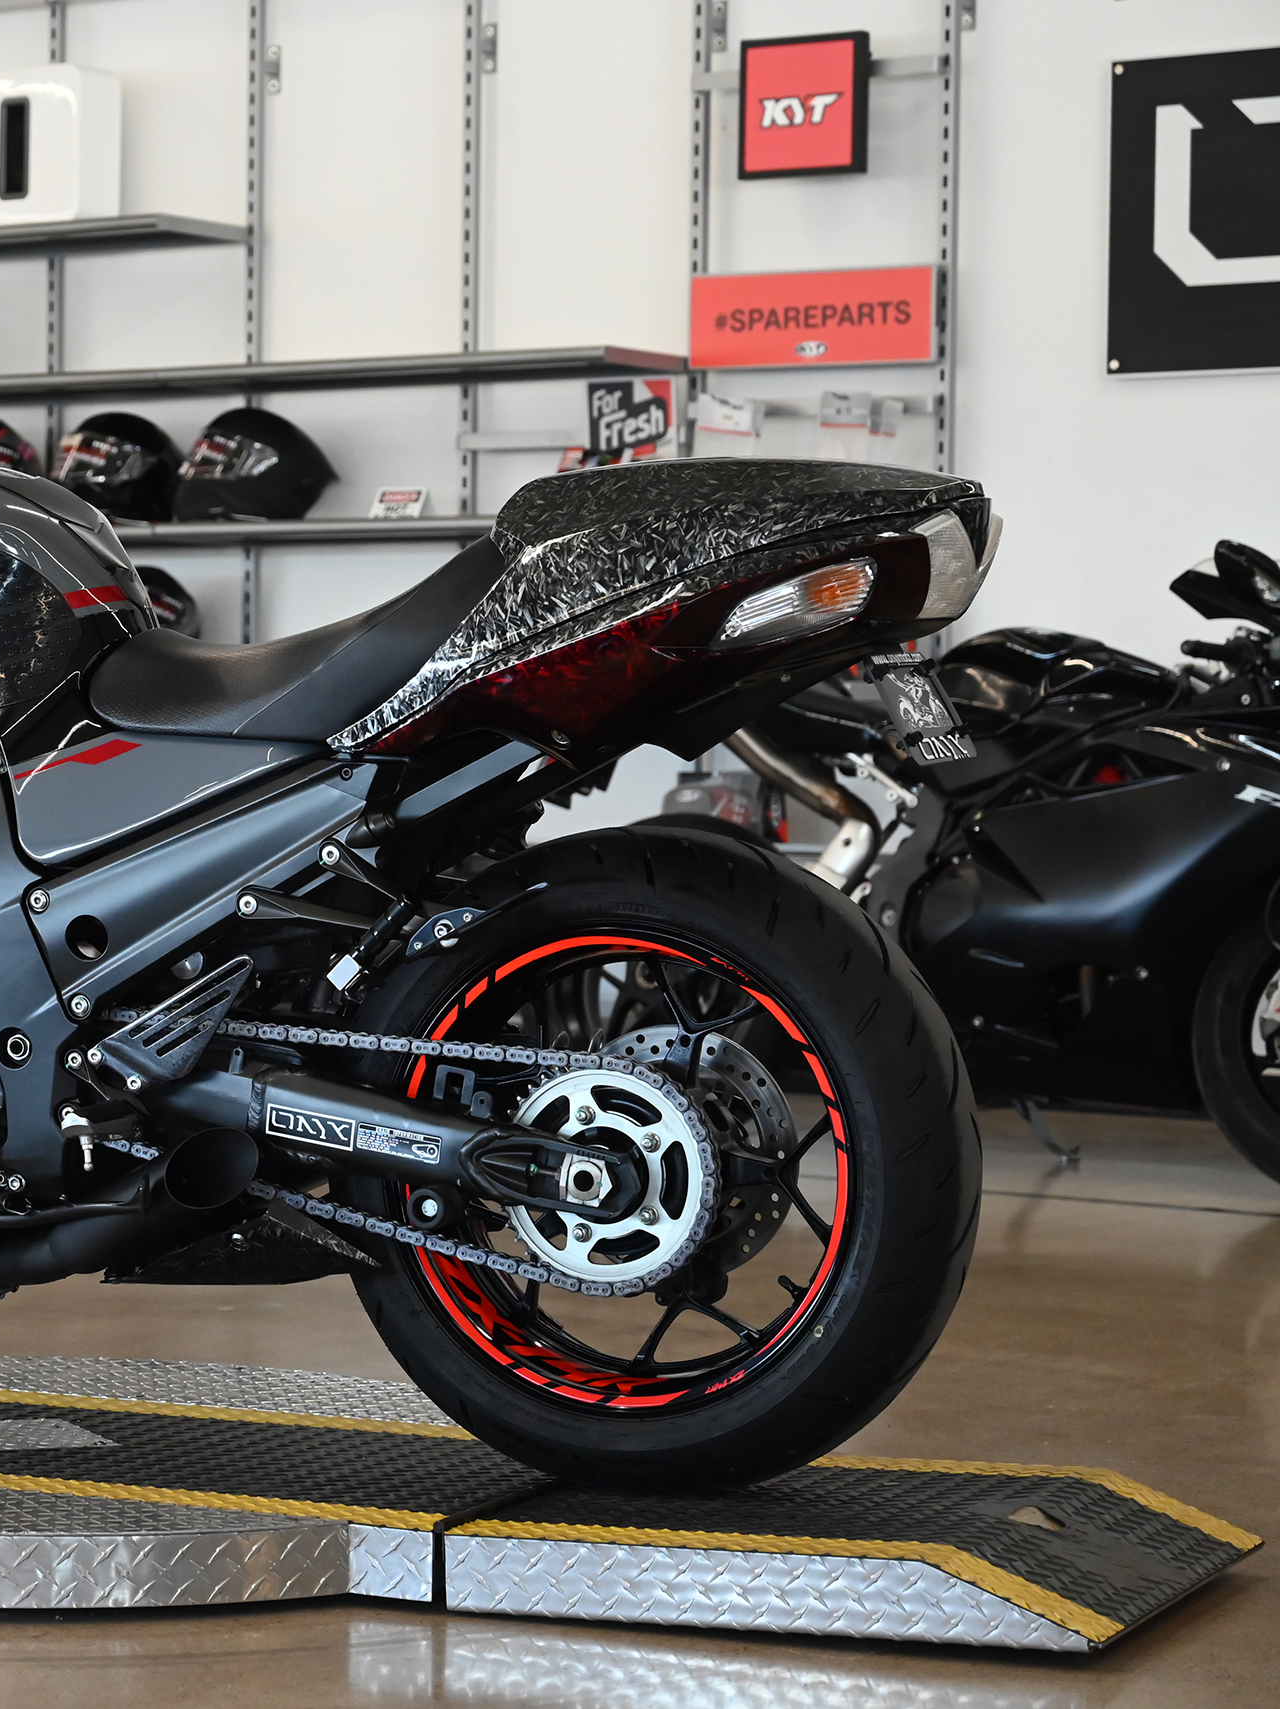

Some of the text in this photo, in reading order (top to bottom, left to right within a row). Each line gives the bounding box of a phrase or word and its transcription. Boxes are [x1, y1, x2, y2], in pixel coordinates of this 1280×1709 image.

[759, 91, 844, 129] KYT
[714, 299, 912, 333] #SPAREPARTS
[591, 387, 624, 420] For
[918, 733, 969, 760] ONYX
[270, 1109, 350, 1142] ONYX
